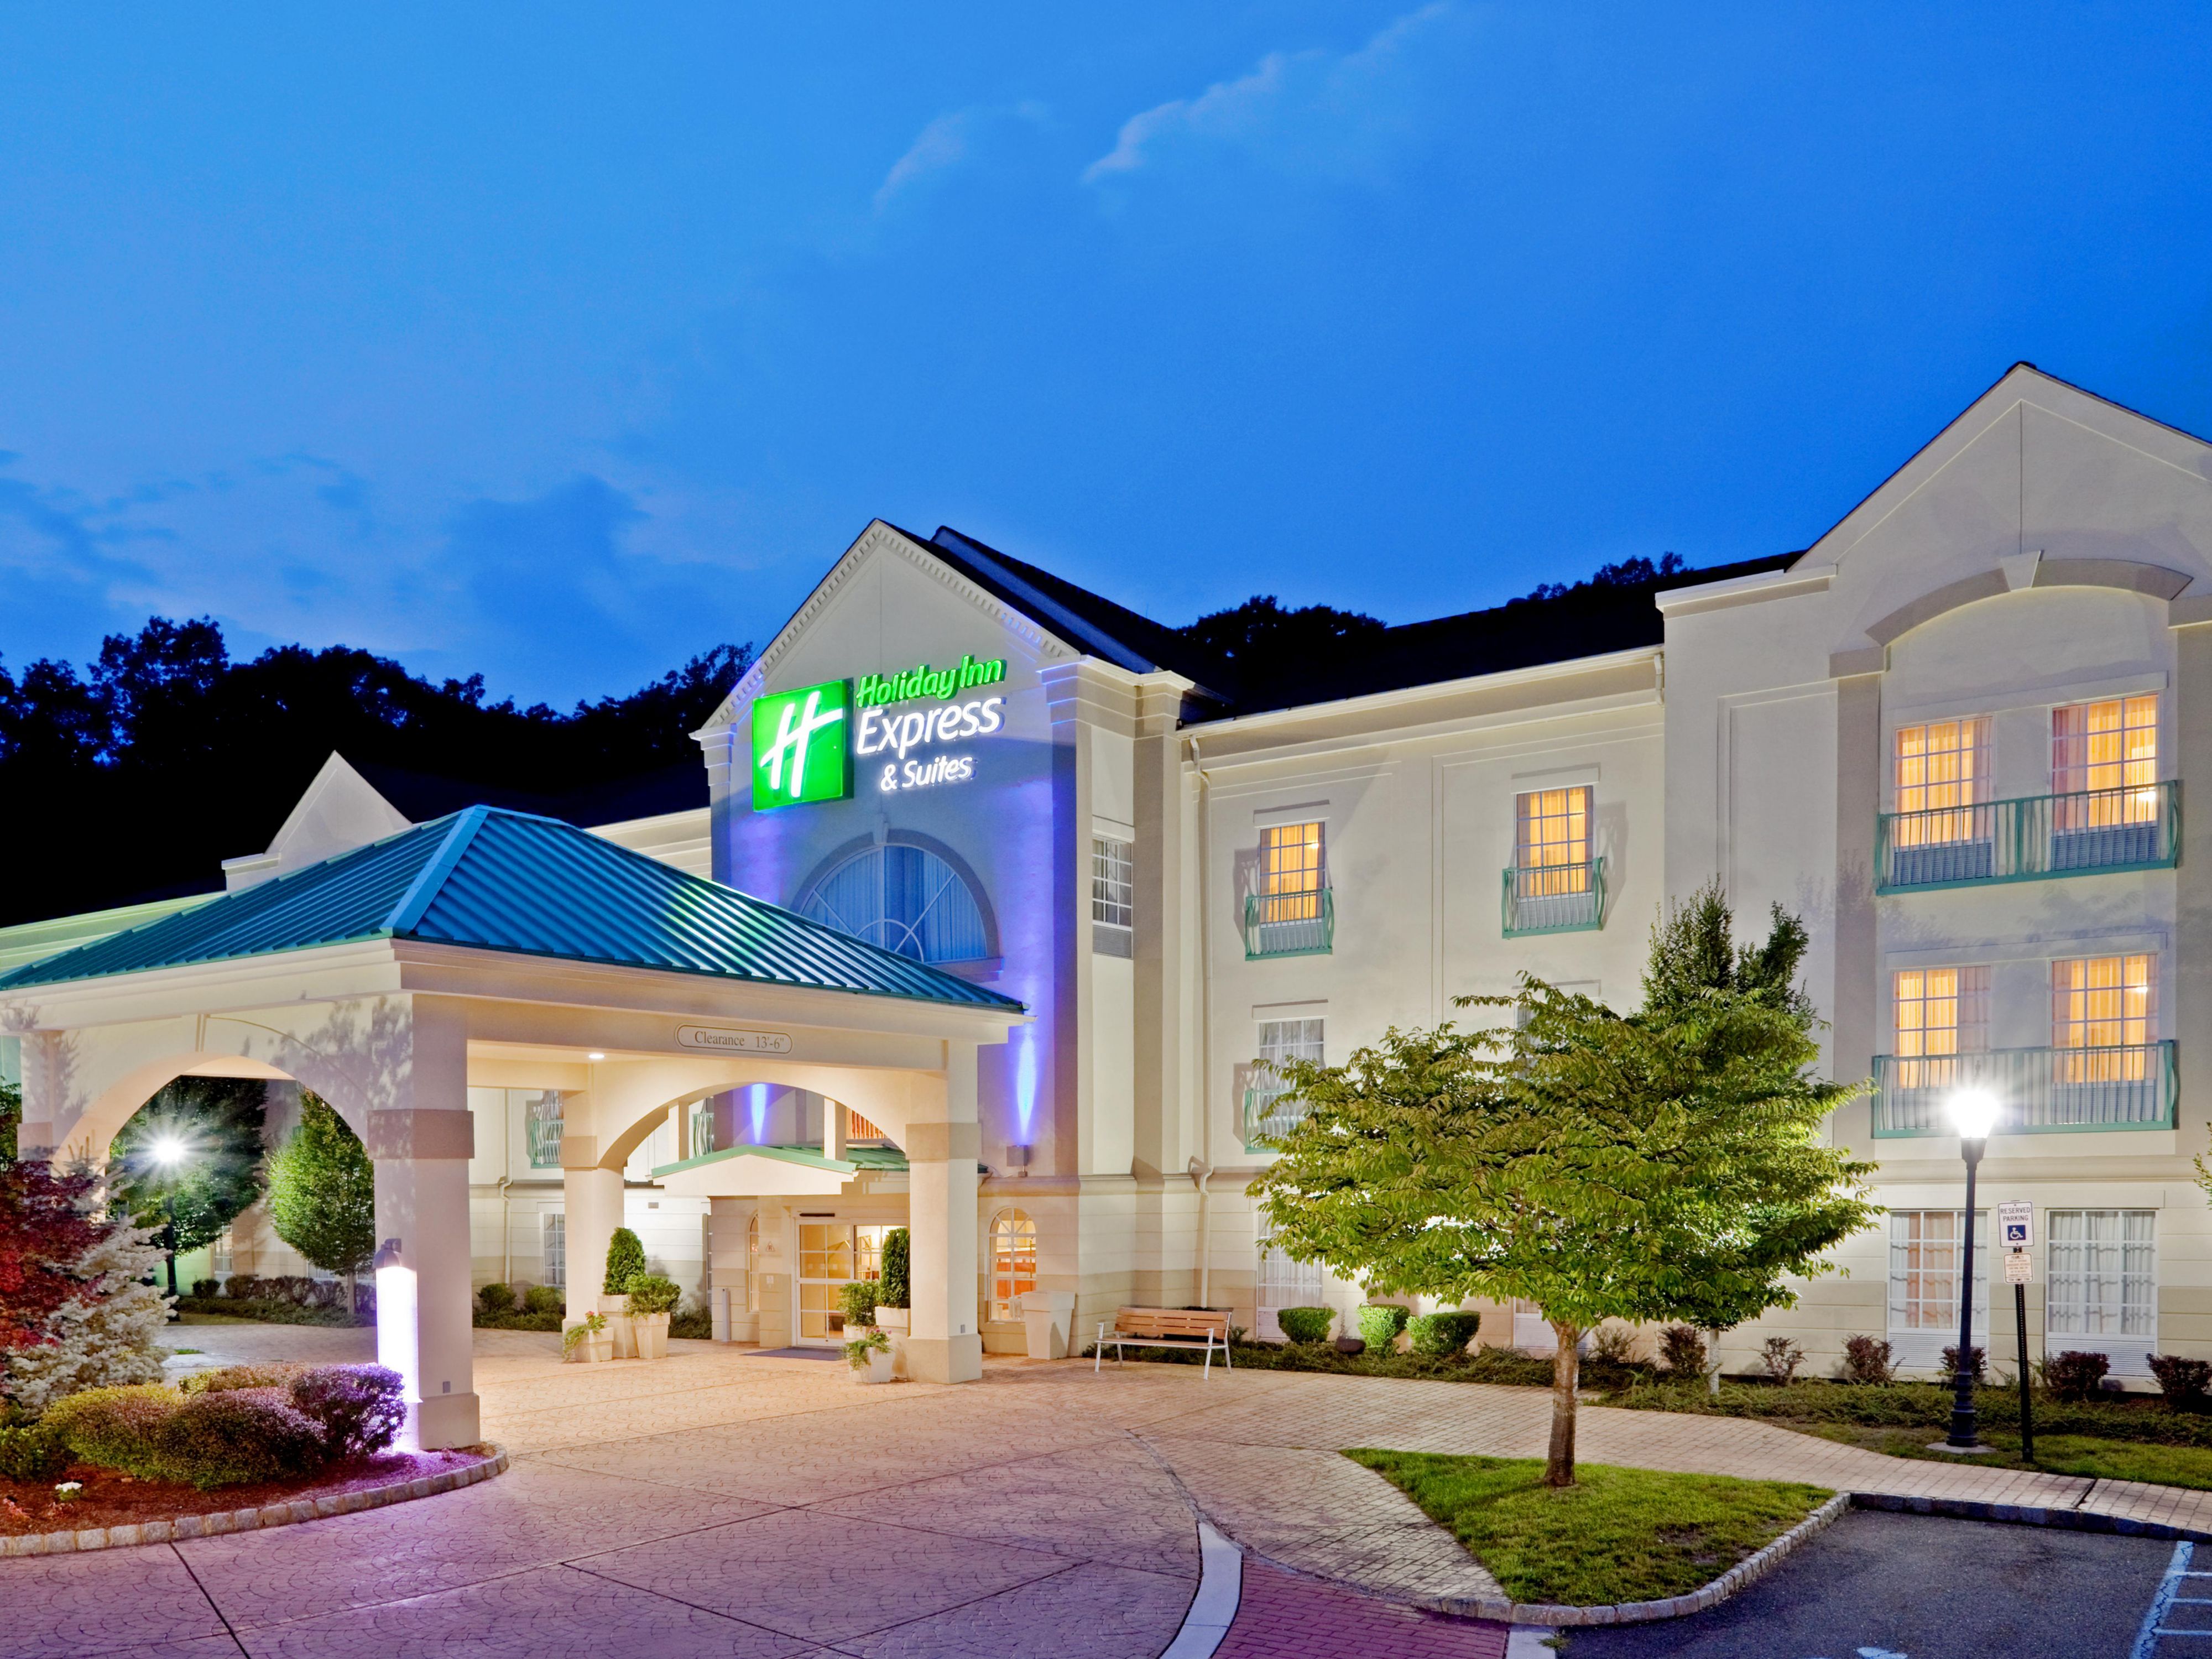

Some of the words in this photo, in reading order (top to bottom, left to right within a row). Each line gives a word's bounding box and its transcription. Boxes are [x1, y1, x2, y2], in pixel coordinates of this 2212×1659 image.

[856, 664, 958, 708] Holiday
[959, 655, 1005, 687] Inn
[857, 697, 1003, 759] Express
[880, 764, 898, 791] &
[902, 755, 974, 787] Suites
[695, 1031, 745, 1046] Clearance
